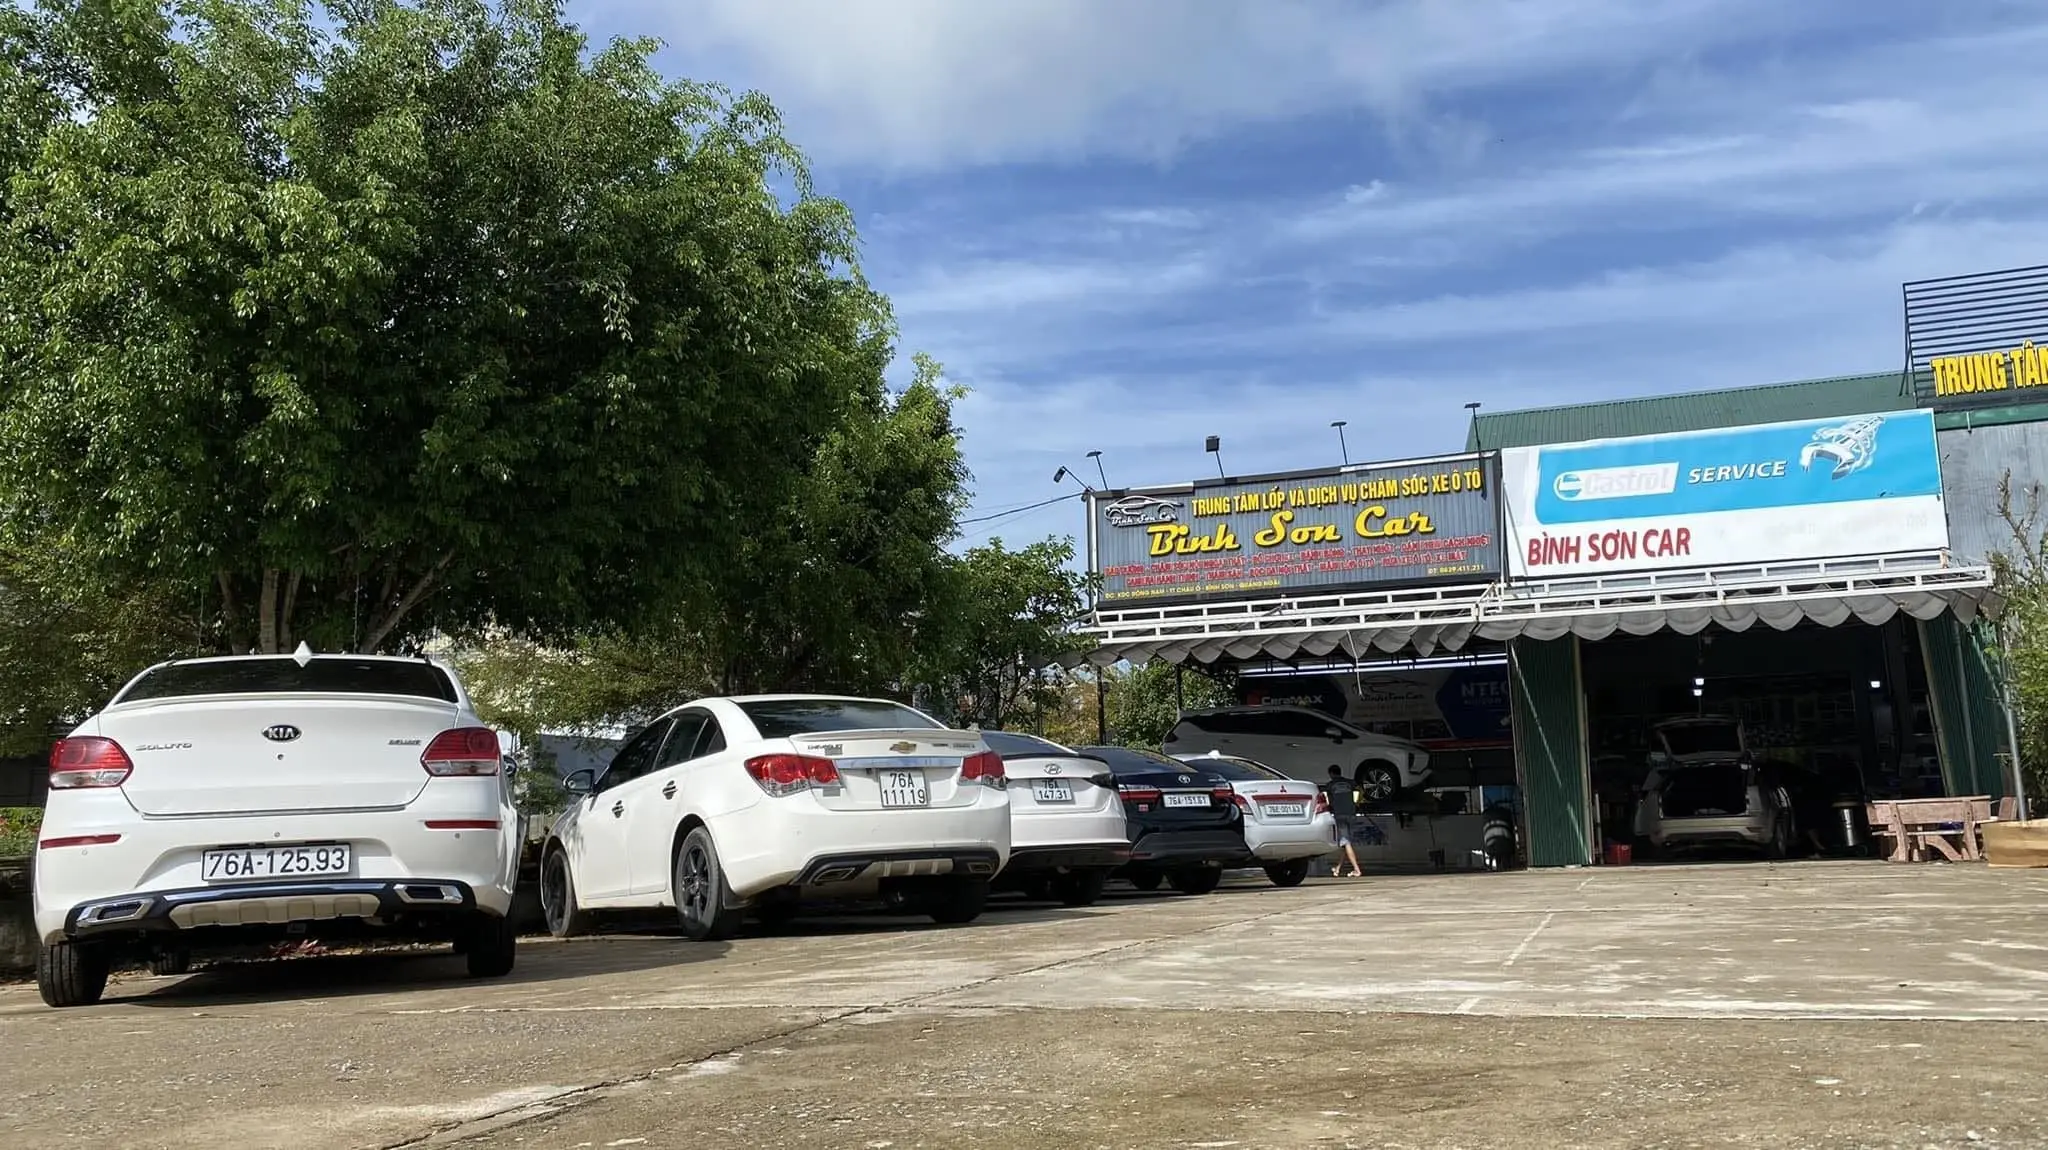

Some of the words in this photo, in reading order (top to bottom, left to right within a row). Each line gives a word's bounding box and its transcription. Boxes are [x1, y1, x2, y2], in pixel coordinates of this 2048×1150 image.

[1931, 352, 2007, 397] TRUNG
[1688, 460, 1788, 485] SERVICE
[1192, 496, 1231, 517] TRUNG
[1233, 491, 1260, 513] TÂM
[1262, 486, 1286, 510] LỐP
[1289, 487, 1306, 507] VÀ
[1308, 485, 1338, 510] DỊCH
[1341, 483, 1358, 505] VỤ
[1361, 477, 1399, 500] CHĂM
[1402, 473, 1429, 496] SÓC
[1432, 474, 1449, 493] XE
[1452, 469, 1461, 491] Ô
[1464, 467, 1482, 490] TÔ
[1355, 505, 1436, 538] Car
[1527, 531, 1581, 566] BÌNH
[1588, 529, 1637, 562] SƠN
[1642, 527, 1691, 559] CAR
[267, 728, 294, 738] KIA
[136, 742, 193, 751] SOLUTO
[889, 772, 915, 789] 76A
[883, 790, 926, 808] 111.19
[1039, 790, 1068, 800] 147.31
[208, 847, 346, 878] 76A-125.93
